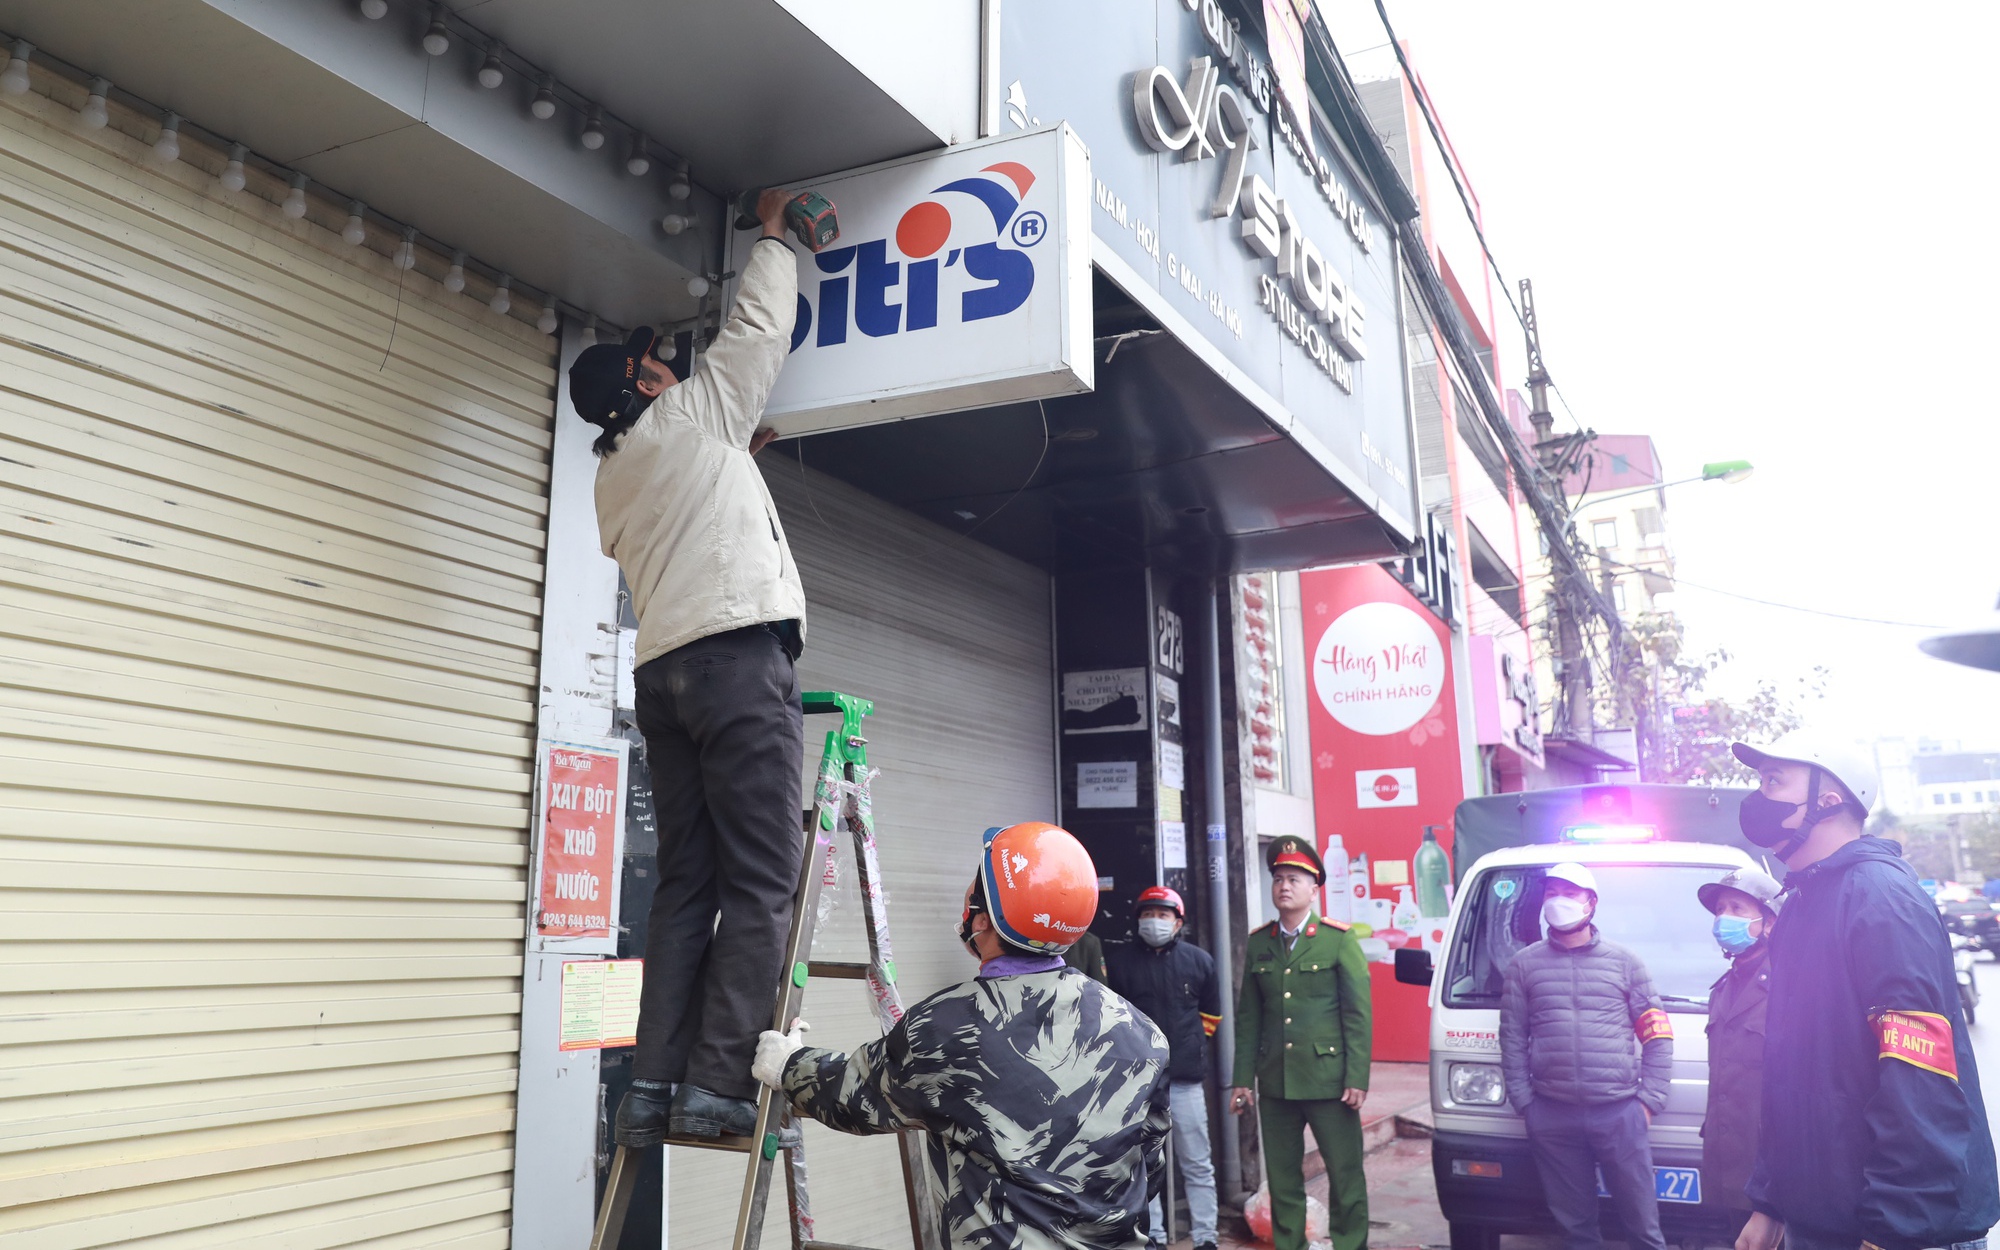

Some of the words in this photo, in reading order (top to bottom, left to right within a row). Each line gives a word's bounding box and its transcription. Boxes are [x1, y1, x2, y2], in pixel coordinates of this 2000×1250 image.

[1095, 178, 1127, 229] NAM
[1180, 262, 1202, 303] MAI
[1209, 289, 1224, 324] HÀ
[1224, 305, 1243, 341] NỘI
[1246, 173, 1367, 361] STORE
[1260, 273, 1299, 340] STYLE
[1299, 313, 1329, 370] FOR
[1328, 344, 1354, 396] MAN
[625, 357, 635, 379] TOUR
[1158, 605, 1184, 676] 273
[1321, 644, 1376, 683] Hàng
[1382, 643, 1430, 673] Nhật
[1332, 687, 1382, 704] CHÍNH
[550, 782, 581, 811] XAY
[584, 783, 614, 819] BỘT
[563, 826, 596, 857] KHÔ
[555, 869, 600, 902] NƯỚC
[1001, 848, 1015, 889] Ahamove
[543, 912, 566, 927] 0243
[568, 914, 583, 928] 644
[585, 915, 606, 928] 6324
[1446, 1030, 1496, 1040] SUPER
[1884, 1028, 1899, 1048] VỆ
[1902, 1034, 1936, 1057] ANTT
